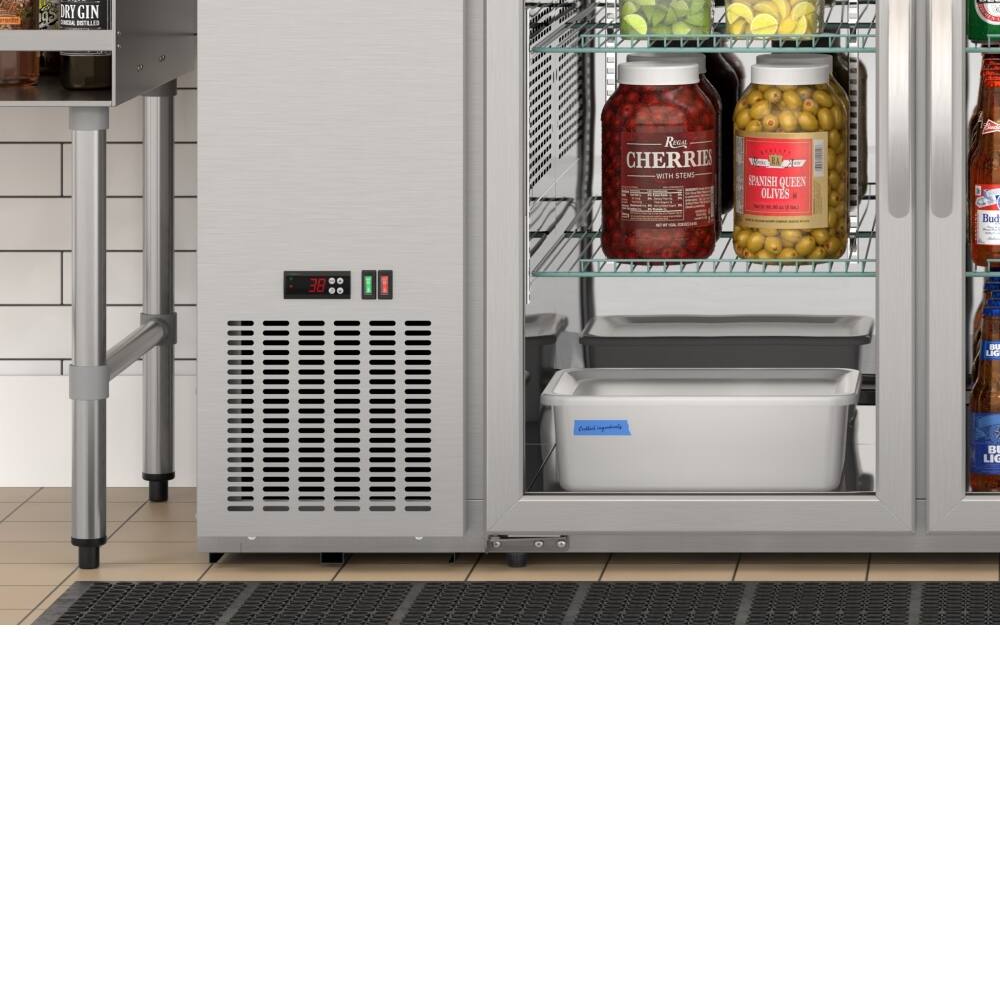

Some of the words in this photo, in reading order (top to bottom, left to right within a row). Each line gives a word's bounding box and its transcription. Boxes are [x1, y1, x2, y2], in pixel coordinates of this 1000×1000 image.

[61, 3, 76, 19] DRY
[77, 3, 100, 19] GIN
[626, 149, 713, 169] CHERRIES
[675, 172, 696, 180] STEMS
[748, 175, 778, 188] SPANISH
[780, 175, 807, 190] QUEEN
[761, 187, 790, 199] OLIVES
